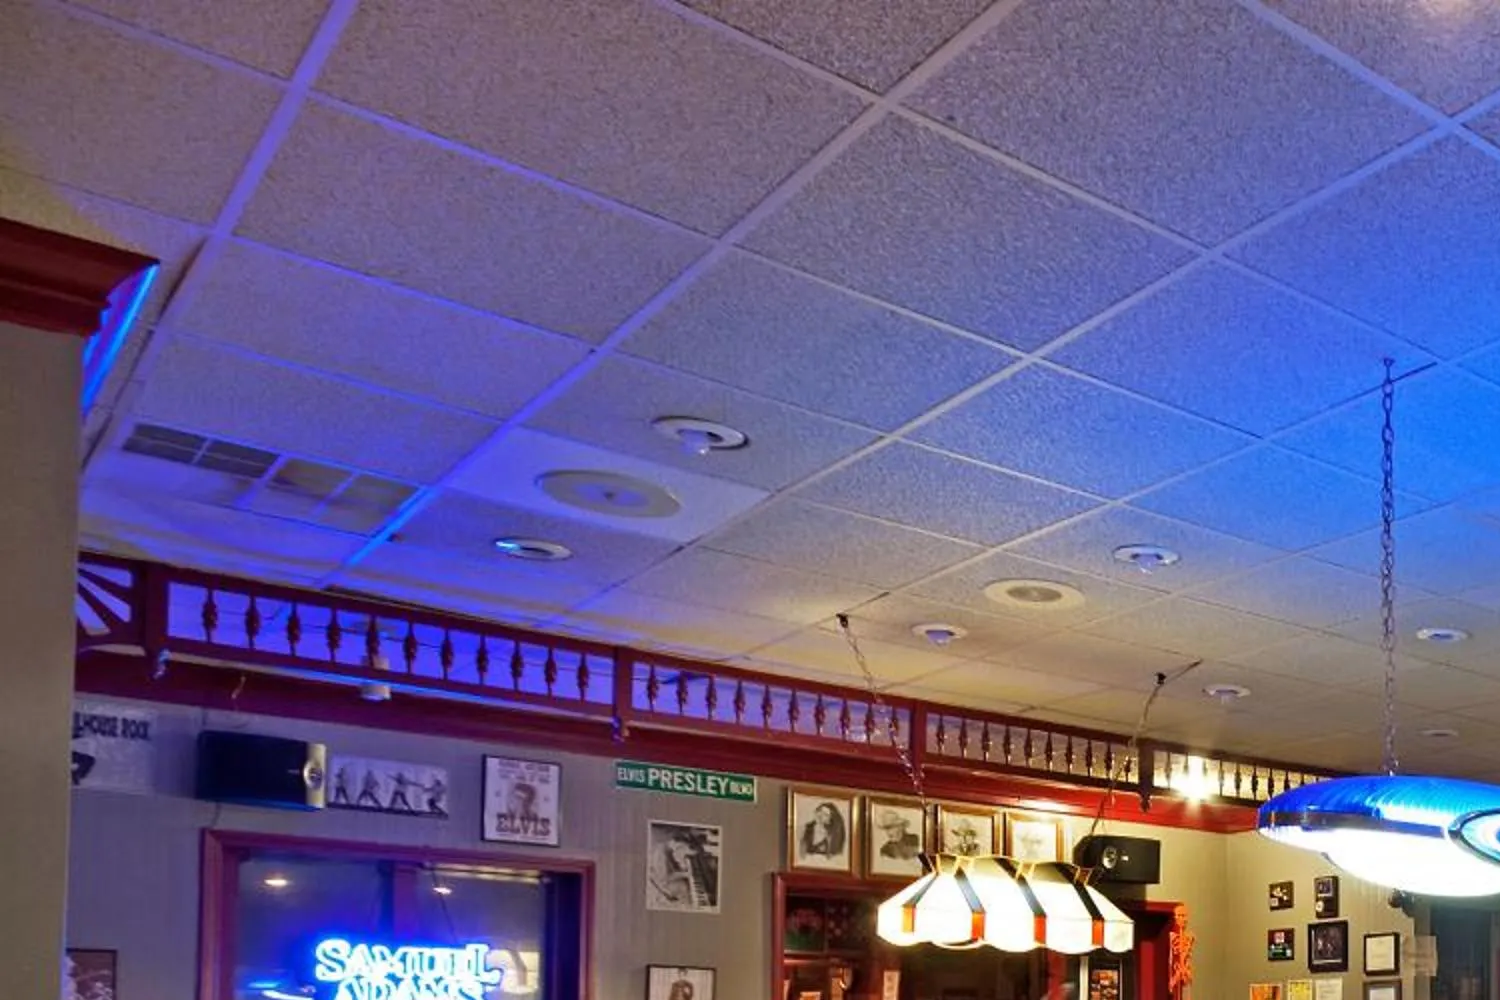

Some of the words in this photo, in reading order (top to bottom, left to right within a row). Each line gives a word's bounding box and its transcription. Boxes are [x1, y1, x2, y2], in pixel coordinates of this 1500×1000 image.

[121, 717, 152, 741] ROCK
[617, 767, 645, 783] ELVIS
[647, 767, 728, 795] PRESLEY
[496, 813, 551, 836] ELVIS
[315, 938, 503, 985] SAMUEL
